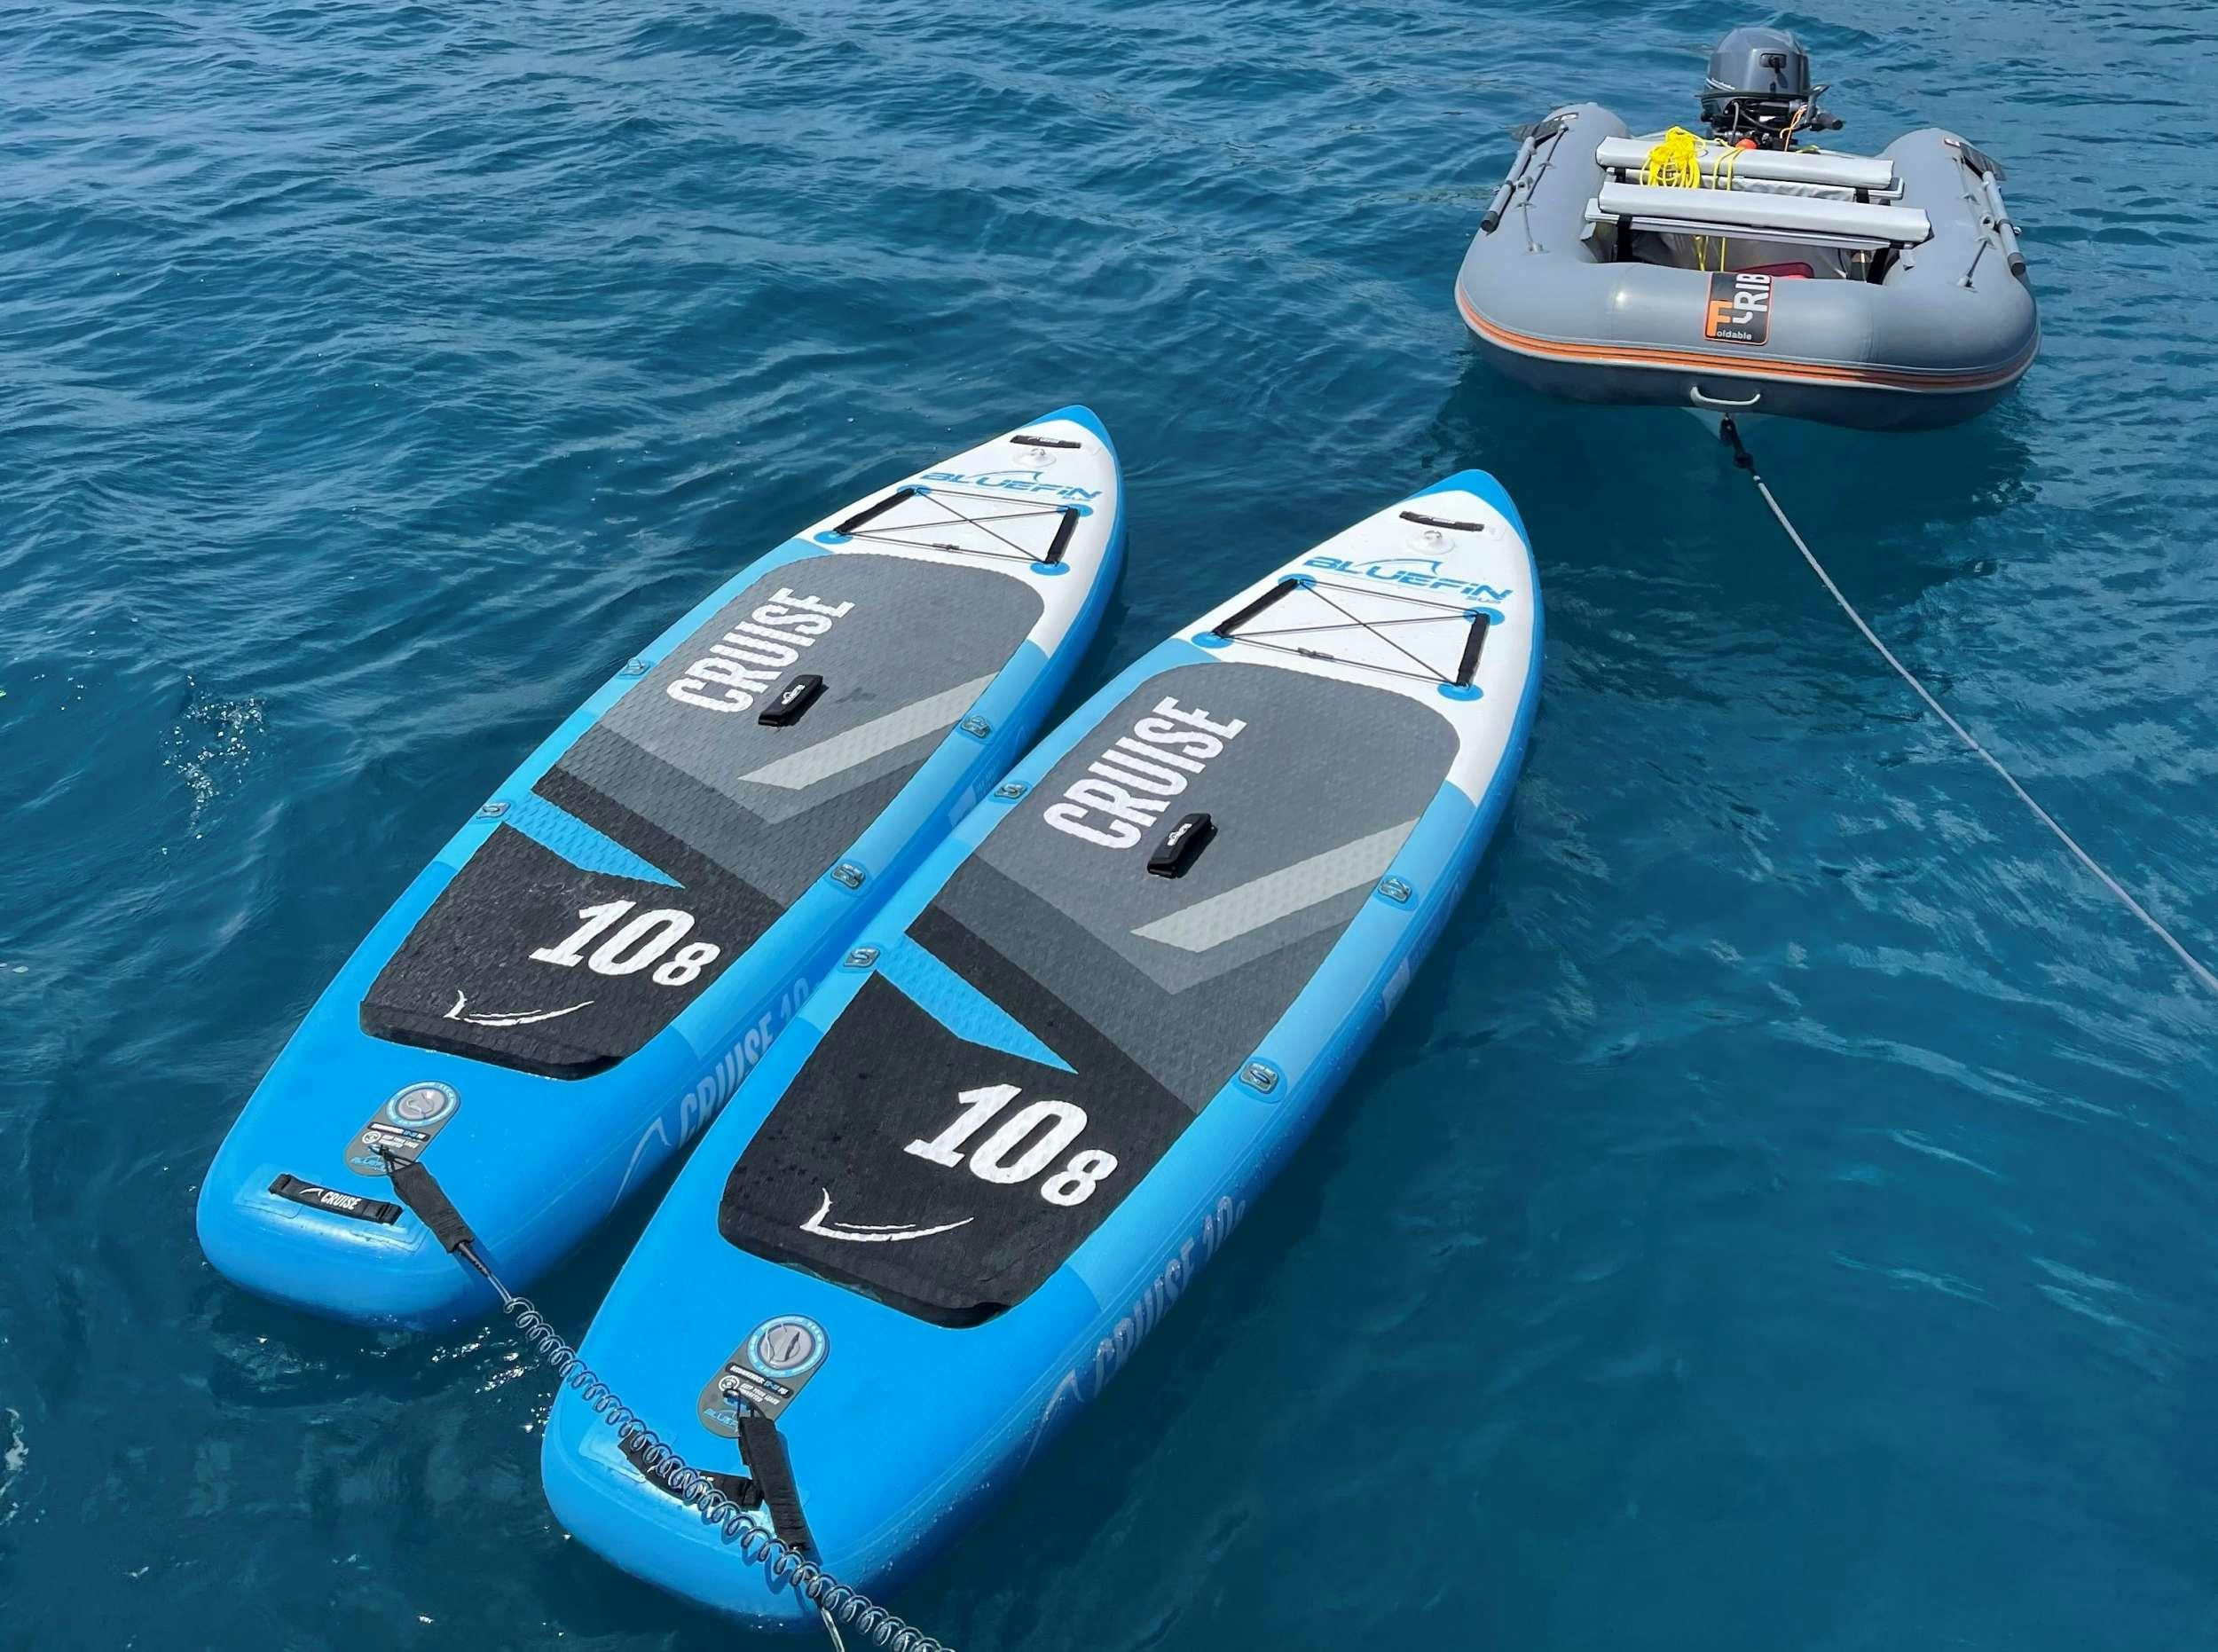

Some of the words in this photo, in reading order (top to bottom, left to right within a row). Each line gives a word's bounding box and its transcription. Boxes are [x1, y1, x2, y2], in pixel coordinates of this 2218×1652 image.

[666, 587, 856, 712] CRUISE
[1042, 696, 1247, 849] CRUISE
[320, 1191, 362, 1210] CRUISE
